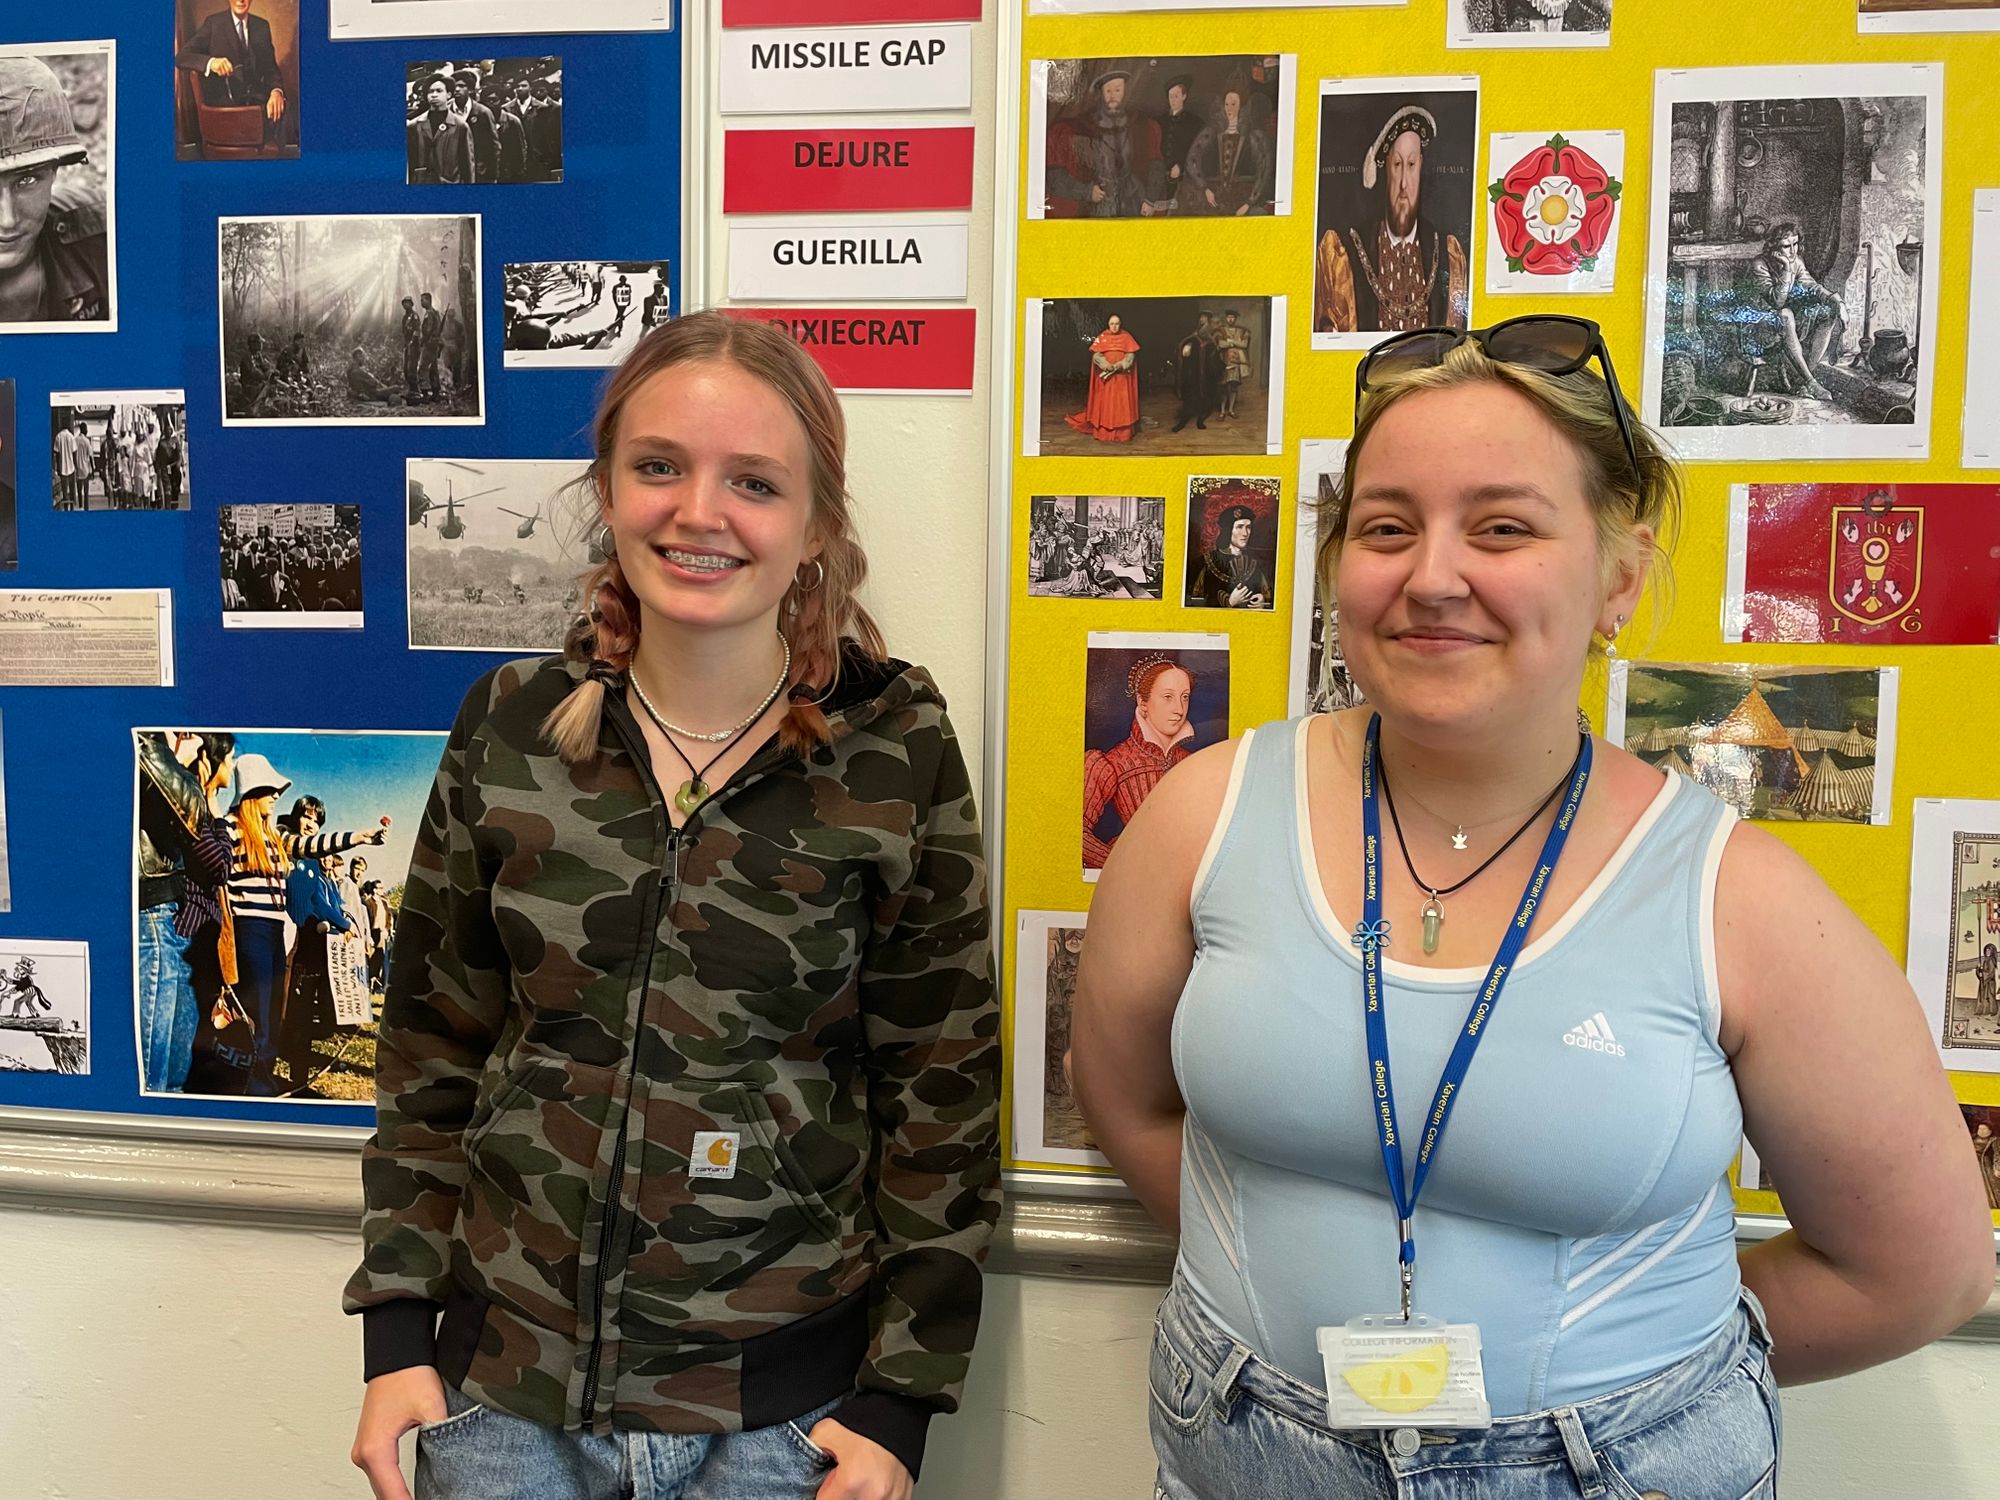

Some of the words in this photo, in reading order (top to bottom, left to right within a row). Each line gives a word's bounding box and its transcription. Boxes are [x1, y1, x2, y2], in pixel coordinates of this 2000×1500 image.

[751, 41, 870, 69] MISSILE
[880, 39, 946, 67] GAP
[794, 141, 910, 168] DEJURE
[773, 238, 922, 265] GUERILLA
[10, 594, 32, 602] The
[1566, 771, 1588, 804] Xaverian
[1558, 802, 1577, 831] College
[1366, 835, 1377, 864] College
[1366, 864, 1377, 901] Xaverian
[1531, 864, 1552, 899] Xaverian
[1517, 898, 1537, 928] College
[1367, 973, 1378, 1012] Xaverian
[1483, 963, 1507, 1001] Xaverian
[1468, 1003, 1490, 1036] College
[1563, 1031, 1626, 1057] adidas
[1374, 1060, 1388, 1098] College
[1432, 1081, 1456, 1126] Xaverian
[1378, 1101, 1396, 1147] Xaverian
[1421, 1127, 1439, 1165] College
